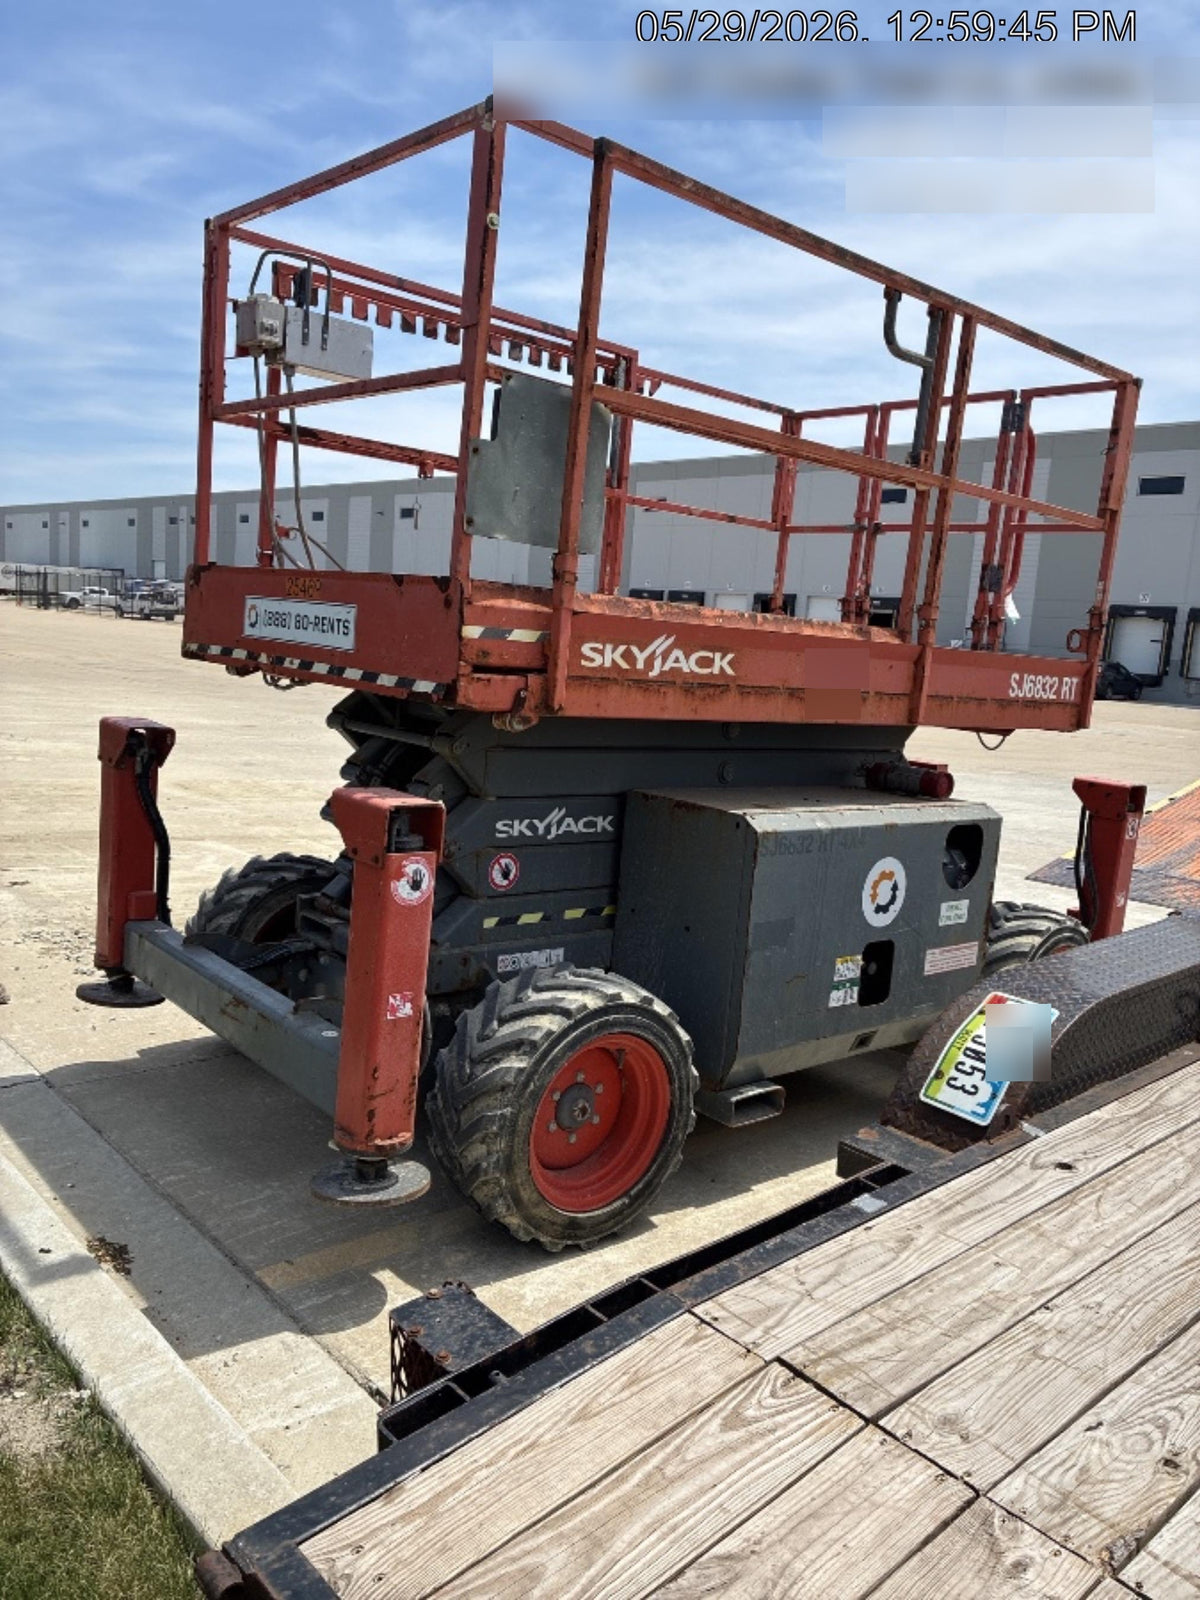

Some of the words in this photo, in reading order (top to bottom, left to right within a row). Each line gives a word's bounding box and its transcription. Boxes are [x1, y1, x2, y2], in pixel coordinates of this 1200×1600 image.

[263, 609, 291, 630] (888)
[580, 633, 736, 677] SKYJACK
[1009, 671, 1059, 700] SJ6832
[1060, 676, 1079, 700] RT
[495, 806, 615, 840] SKYJACK
